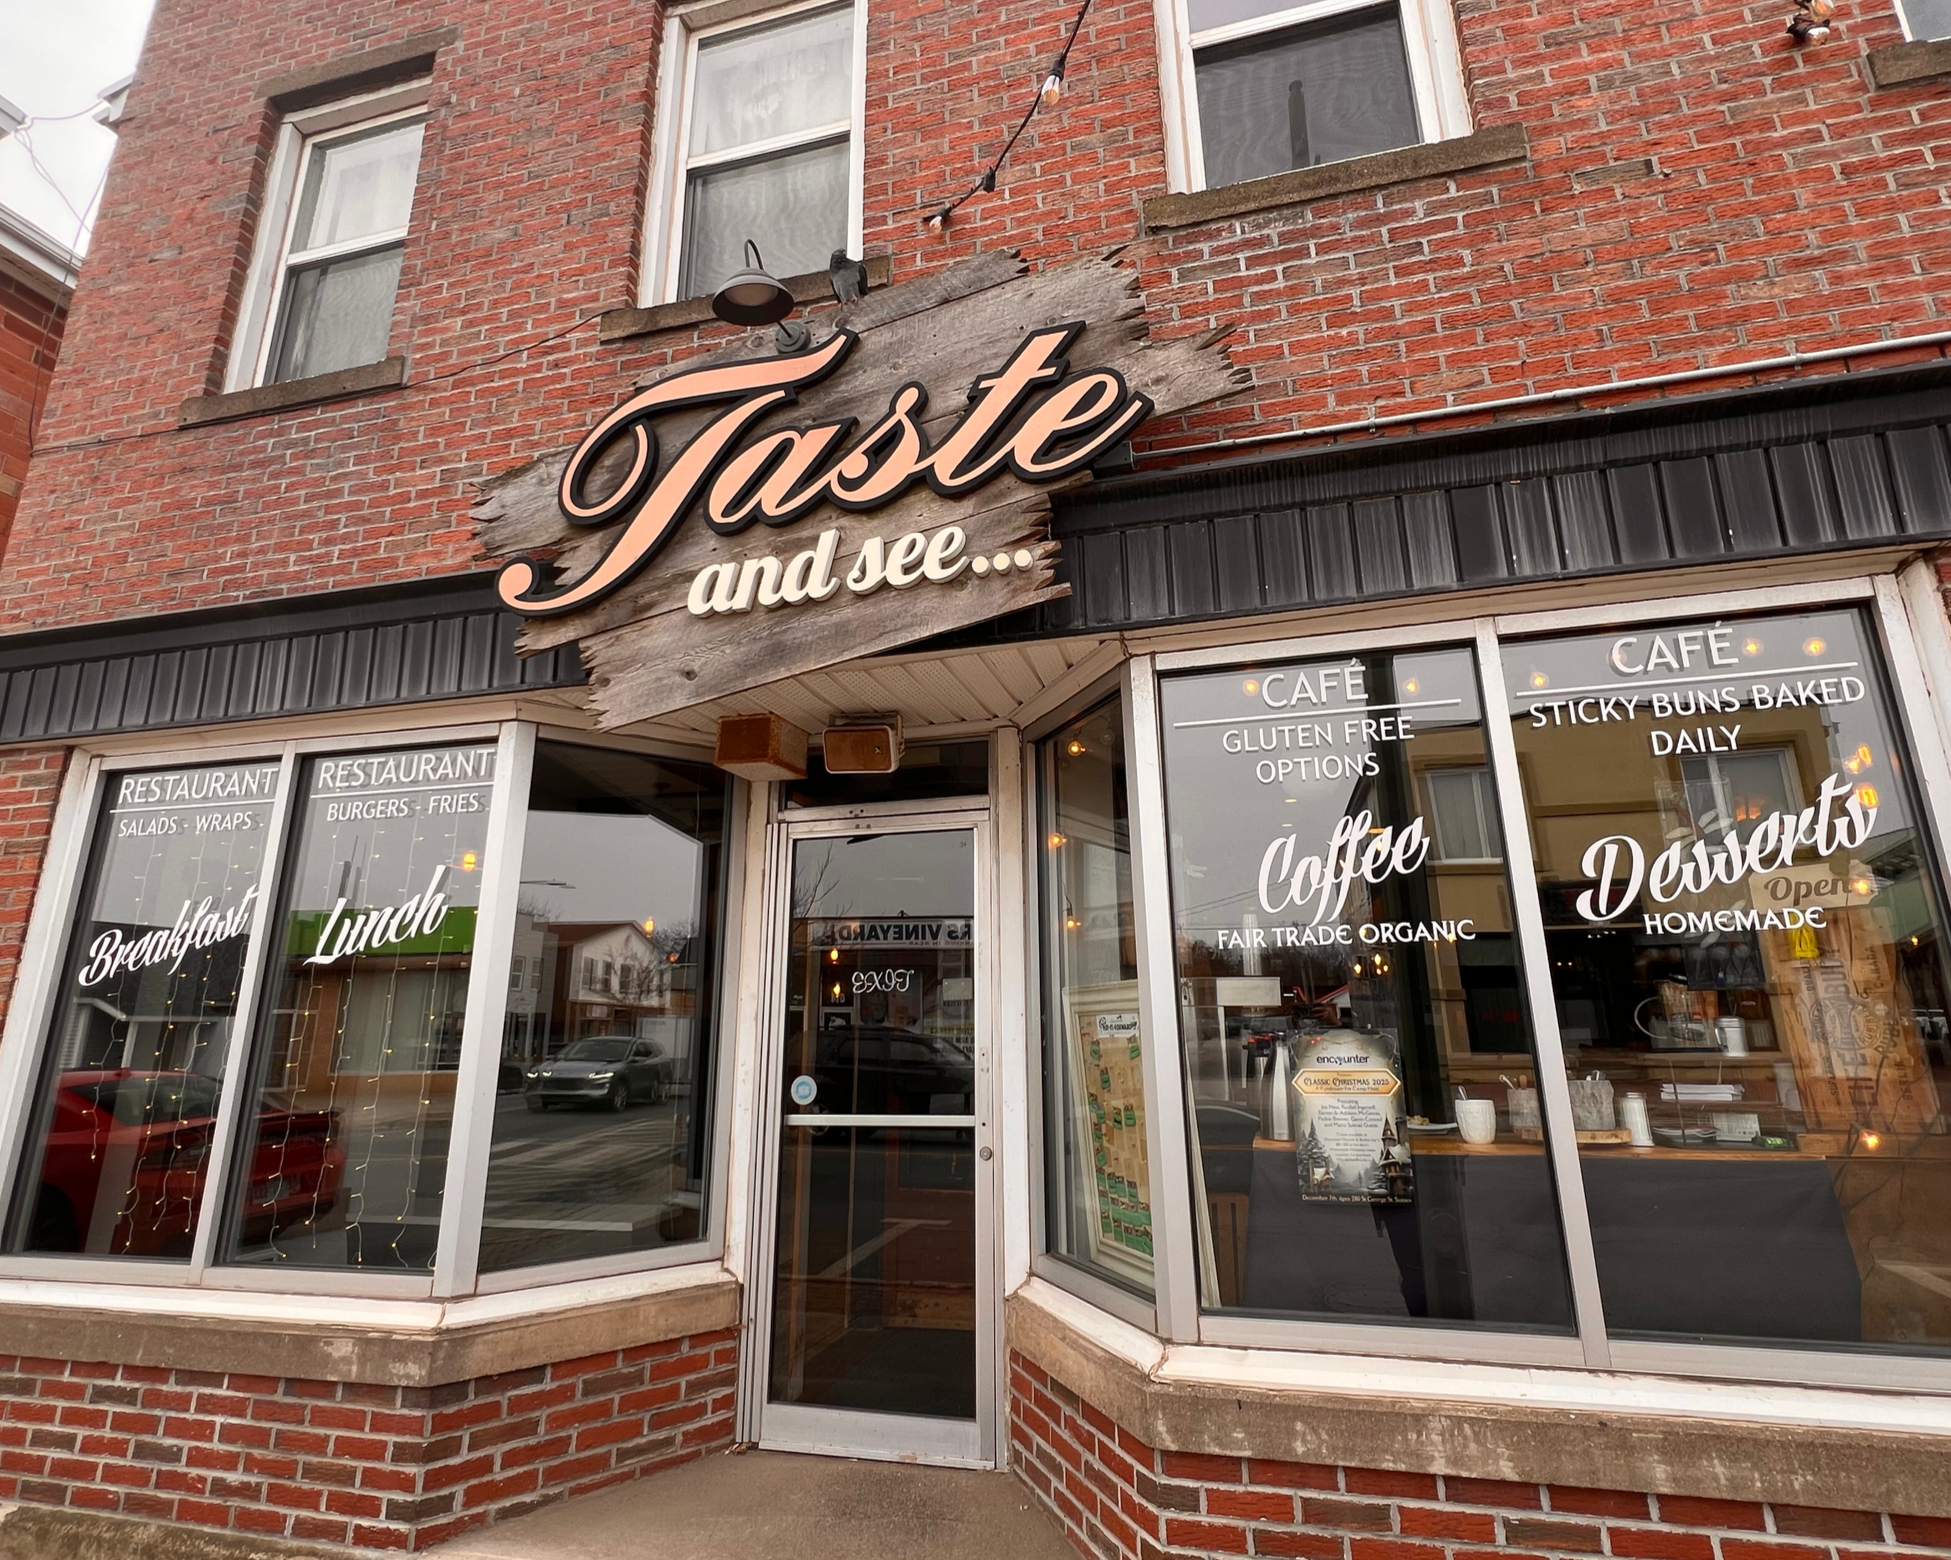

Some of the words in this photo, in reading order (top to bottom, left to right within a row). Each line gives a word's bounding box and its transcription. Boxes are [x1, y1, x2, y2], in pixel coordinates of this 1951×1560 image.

[498, 320, 1154, 617] Taste
[687, 527, 845, 618] and
[1612, 621, 1739, 674] CAFÉ
[1262, 657, 1369, 708] CAFÉ
[1529, 695, 1640, 728] STICKY
[1652, 686, 1740, 719] BUNS
[1752, 676, 1866, 710] BAKED
[1222, 722, 1333, 753] GLUTEN
[1343, 716, 1415, 744] FREE
[1650, 724, 1741, 756] DAILY
[118, 767, 279, 804] RESTAURANT
[318, 748, 496, 789] RESTAURANT
[1255, 752, 1380, 784] OPTIONS
[118, 815, 178, 838] SALADS
[195, 811, 253, 833] WRAPS
[327, 798, 409, 822] BURGERS
[428, 792, 479, 815] FRIES
[1576, 772, 1878, 921] Desserts
[1258, 809, 1430, 927] Coffee
[1764, 876, 1852, 907] Open
[302, 864, 449, 966] Lunch
[1642, 905, 1827, 935] HOMEMADE
[78, 883, 260, 987] Breakfast
[1217, 928, 1267, 950] FAIR
[1271, 925, 1353, 947] TRADE
[1358, 919, 1477, 944] ORGANIC
[851, 968, 915, 994] EXIT
[1316, 1054, 1370, 1066] encounter
[1332, 1077, 1371, 1086] CHRISTMAS
